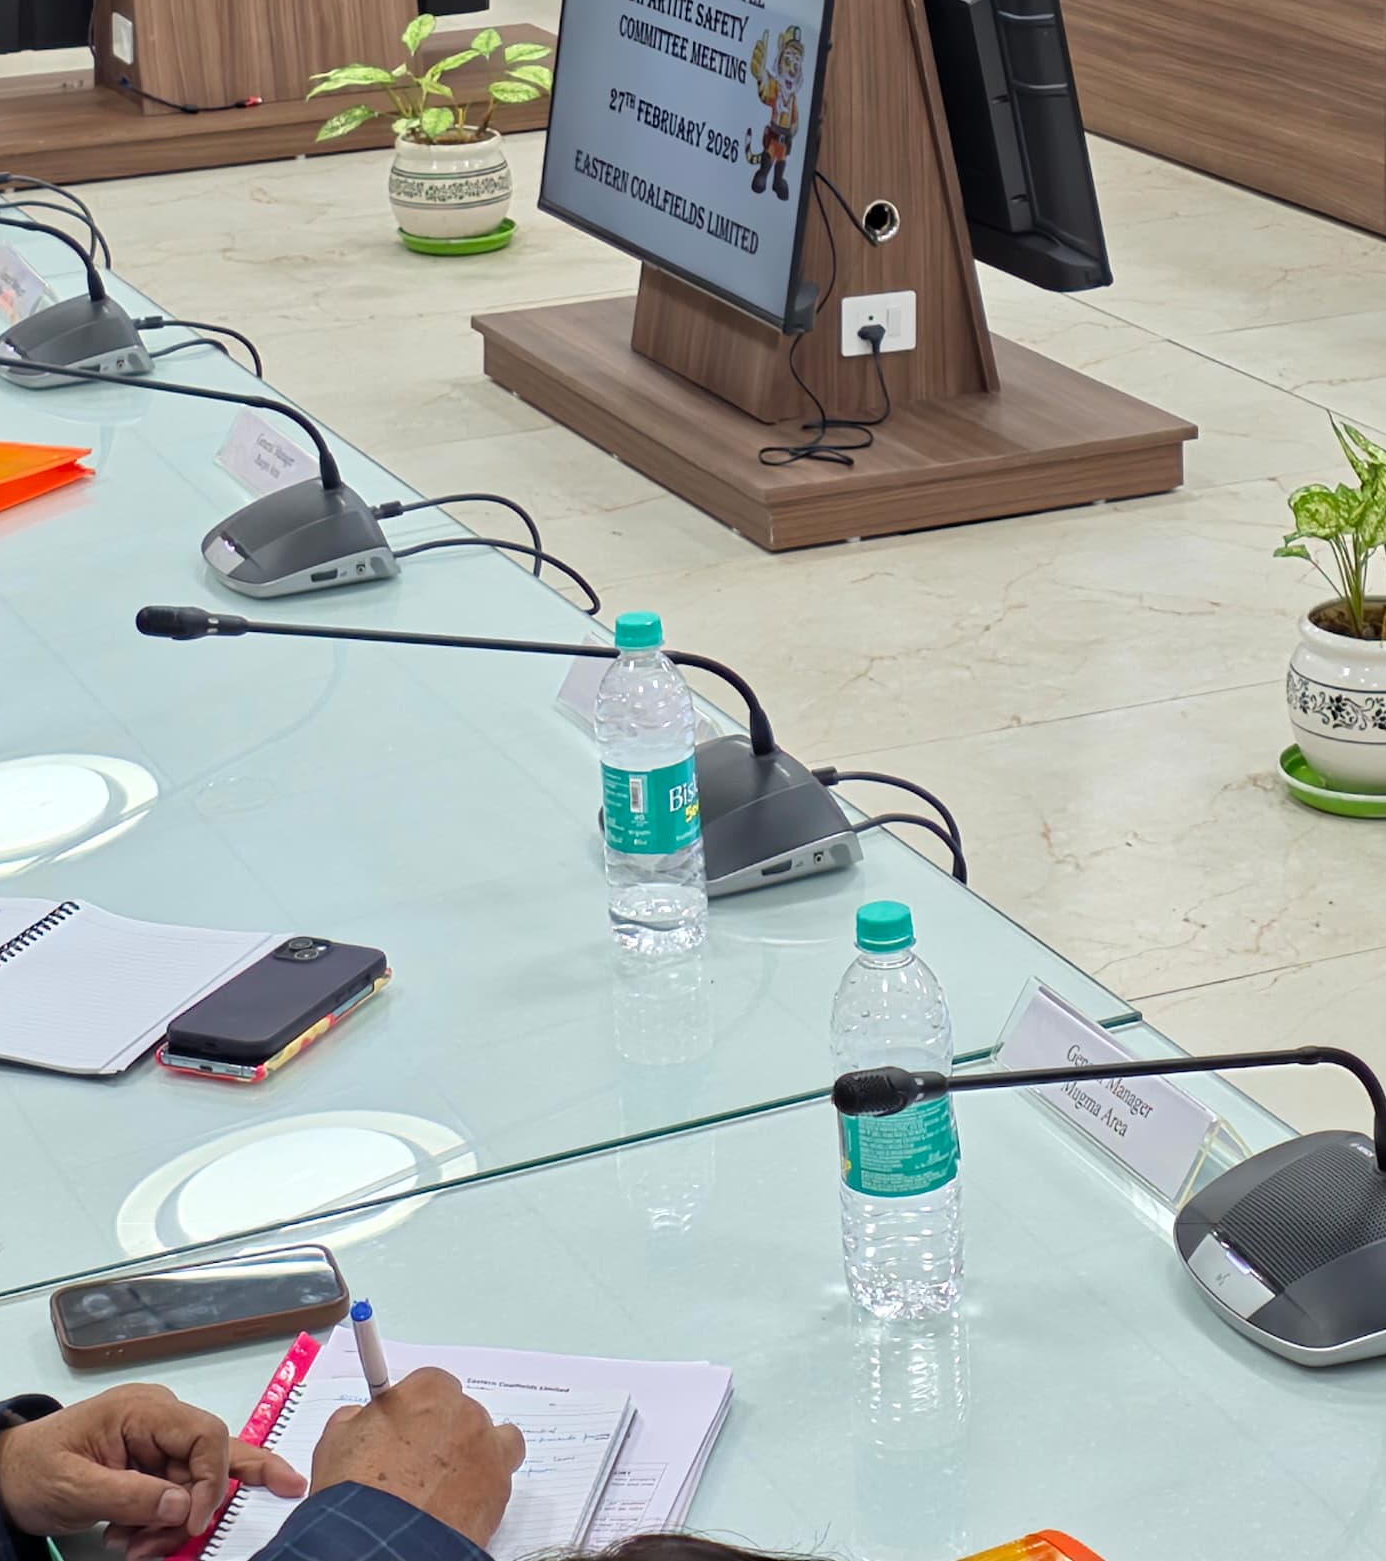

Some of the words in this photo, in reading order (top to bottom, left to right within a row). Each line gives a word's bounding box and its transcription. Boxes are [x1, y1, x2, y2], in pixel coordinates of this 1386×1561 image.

[619, 14, 689, 61] COMMITTEE
[690, 41, 747, 84] MEETING
[695, 3, 749, 42] SAFETY
[609, 88, 636, 113] 27TH
[637, 99, 707, 148] FEBRUARY
[705, 129, 740, 163] 2026
[574, 149, 629, 193] EASTERN
[630, 176, 705, 230] COALFIELDS
[707, 211, 759, 255] LIMITED
[1060, 1082, 1102, 1117] Mugma
[1100, 1107, 1129, 1137] Area
[1105, 1077, 1153, 1119] Manager
